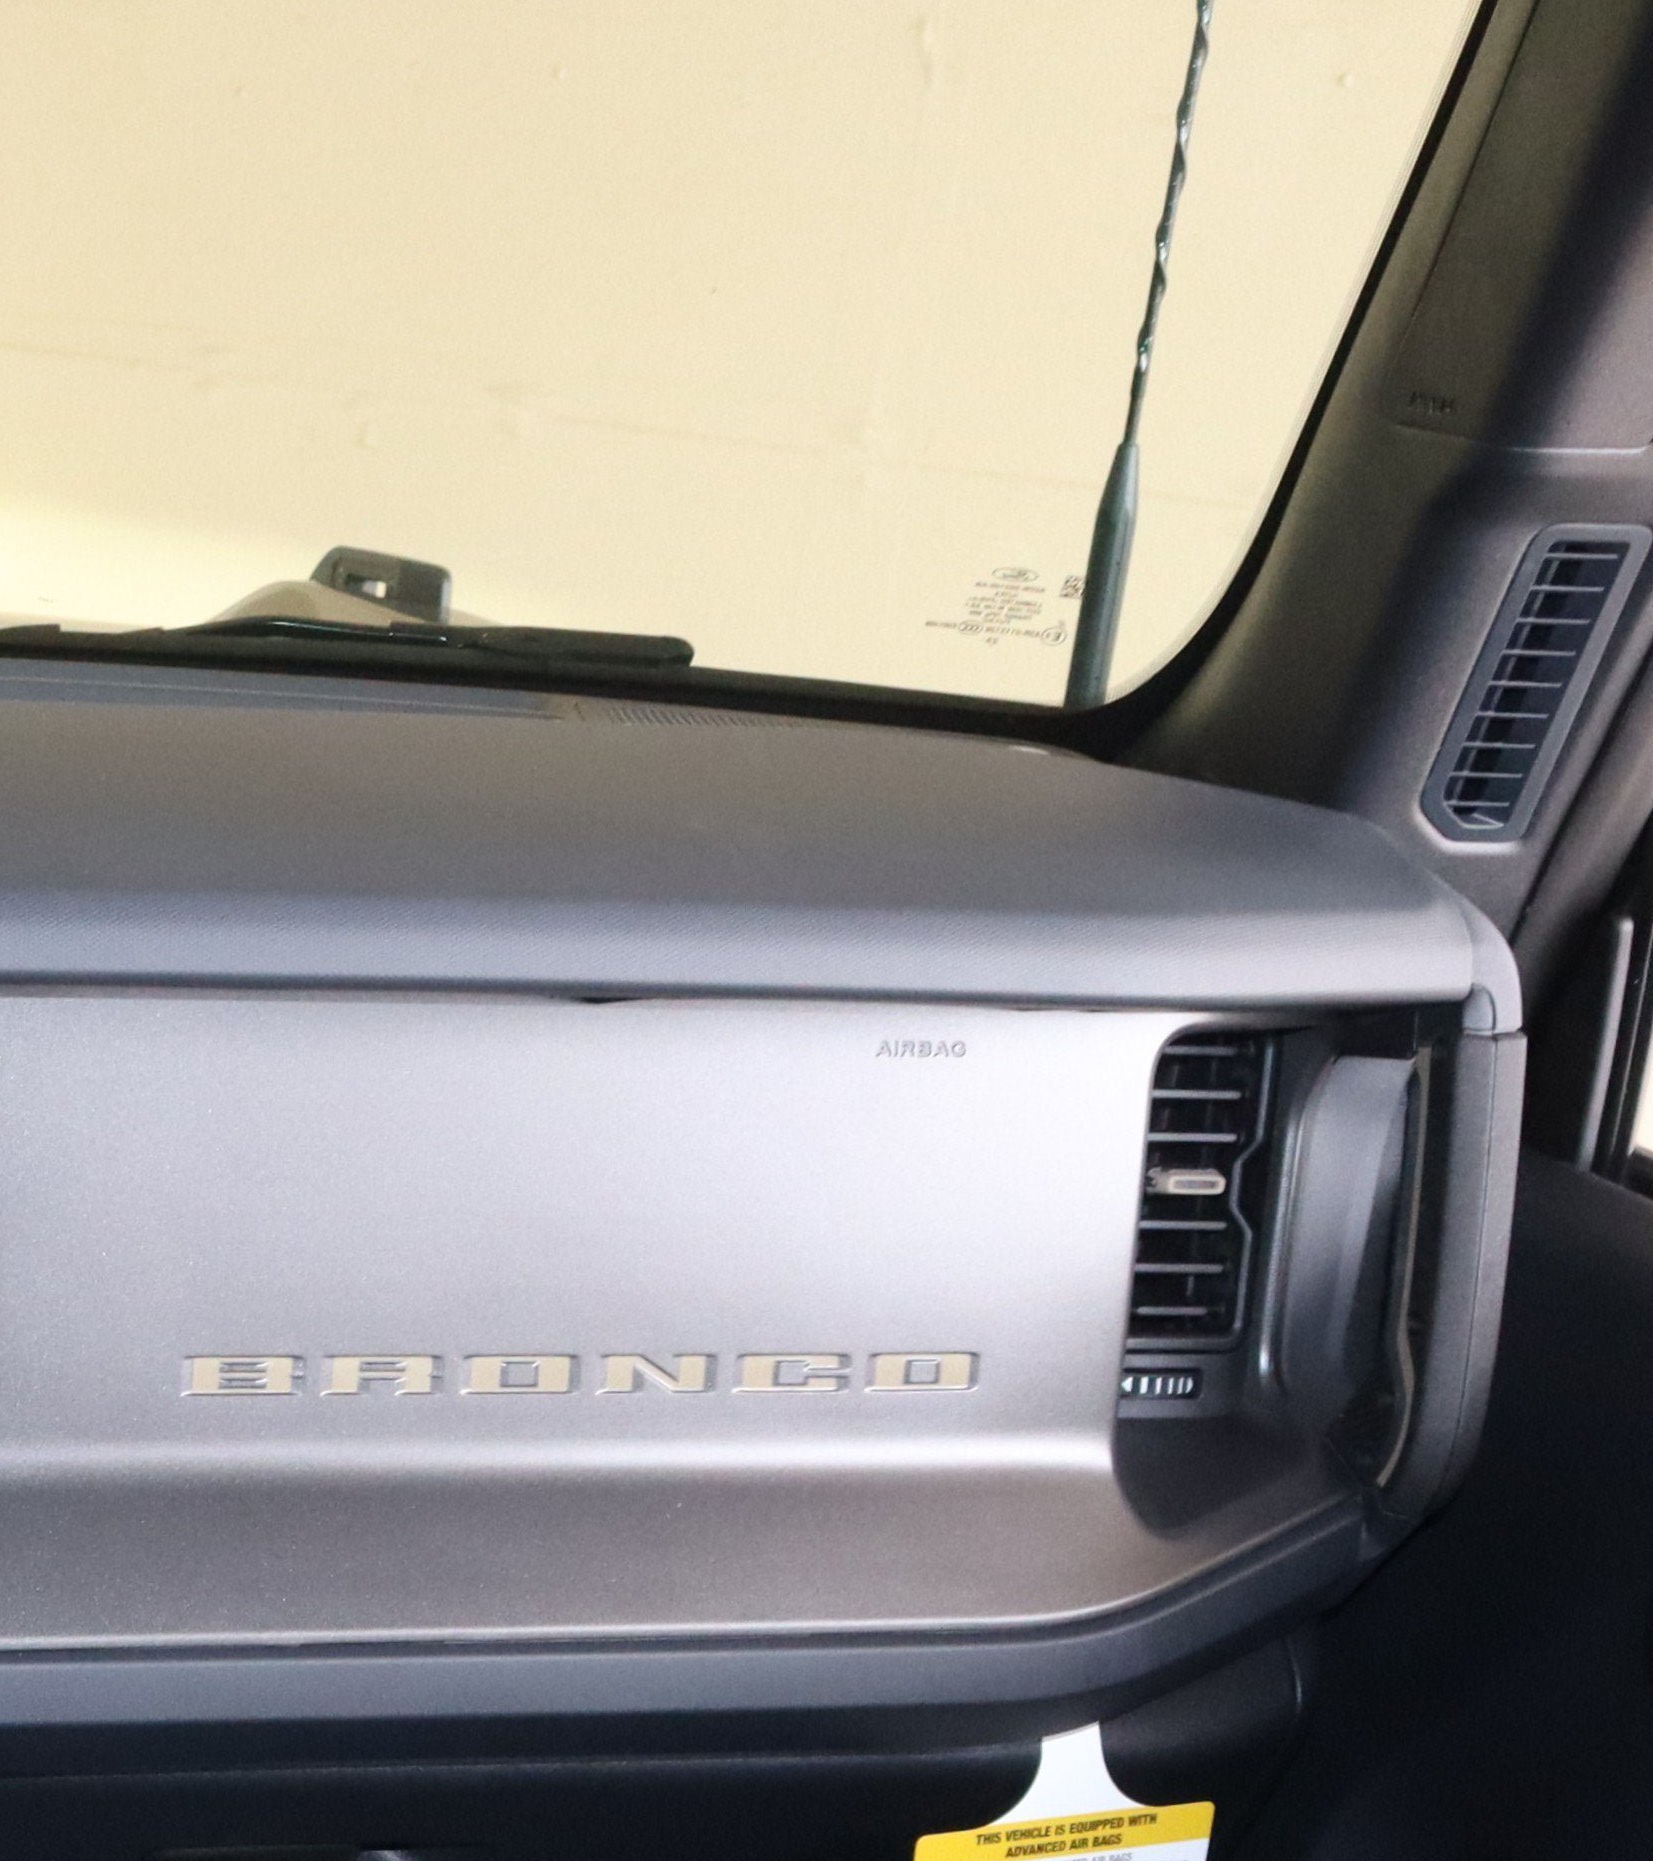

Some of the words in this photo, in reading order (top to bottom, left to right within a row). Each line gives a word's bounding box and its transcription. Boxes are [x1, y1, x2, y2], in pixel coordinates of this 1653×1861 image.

[875, 1040, 967, 1058] AIRBAG
[180, 1352, 981, 1398] BRONCO
[975, 1831, 1002, 1845] THIS
[1005, 1825, 1053, 1842] VEHICLE
[1054, 1823, 1065, 1836] IS
[1069, 1816, 1125, 1834] EQUIPPED
[1127, 1812, 1158, 1827] WITH
[1005, 1840, 1066, 1858] ADVANCED
[1069, 1837, 1089, 1850] AIR
[1092, 1833, 1123, 1847] BAGS
